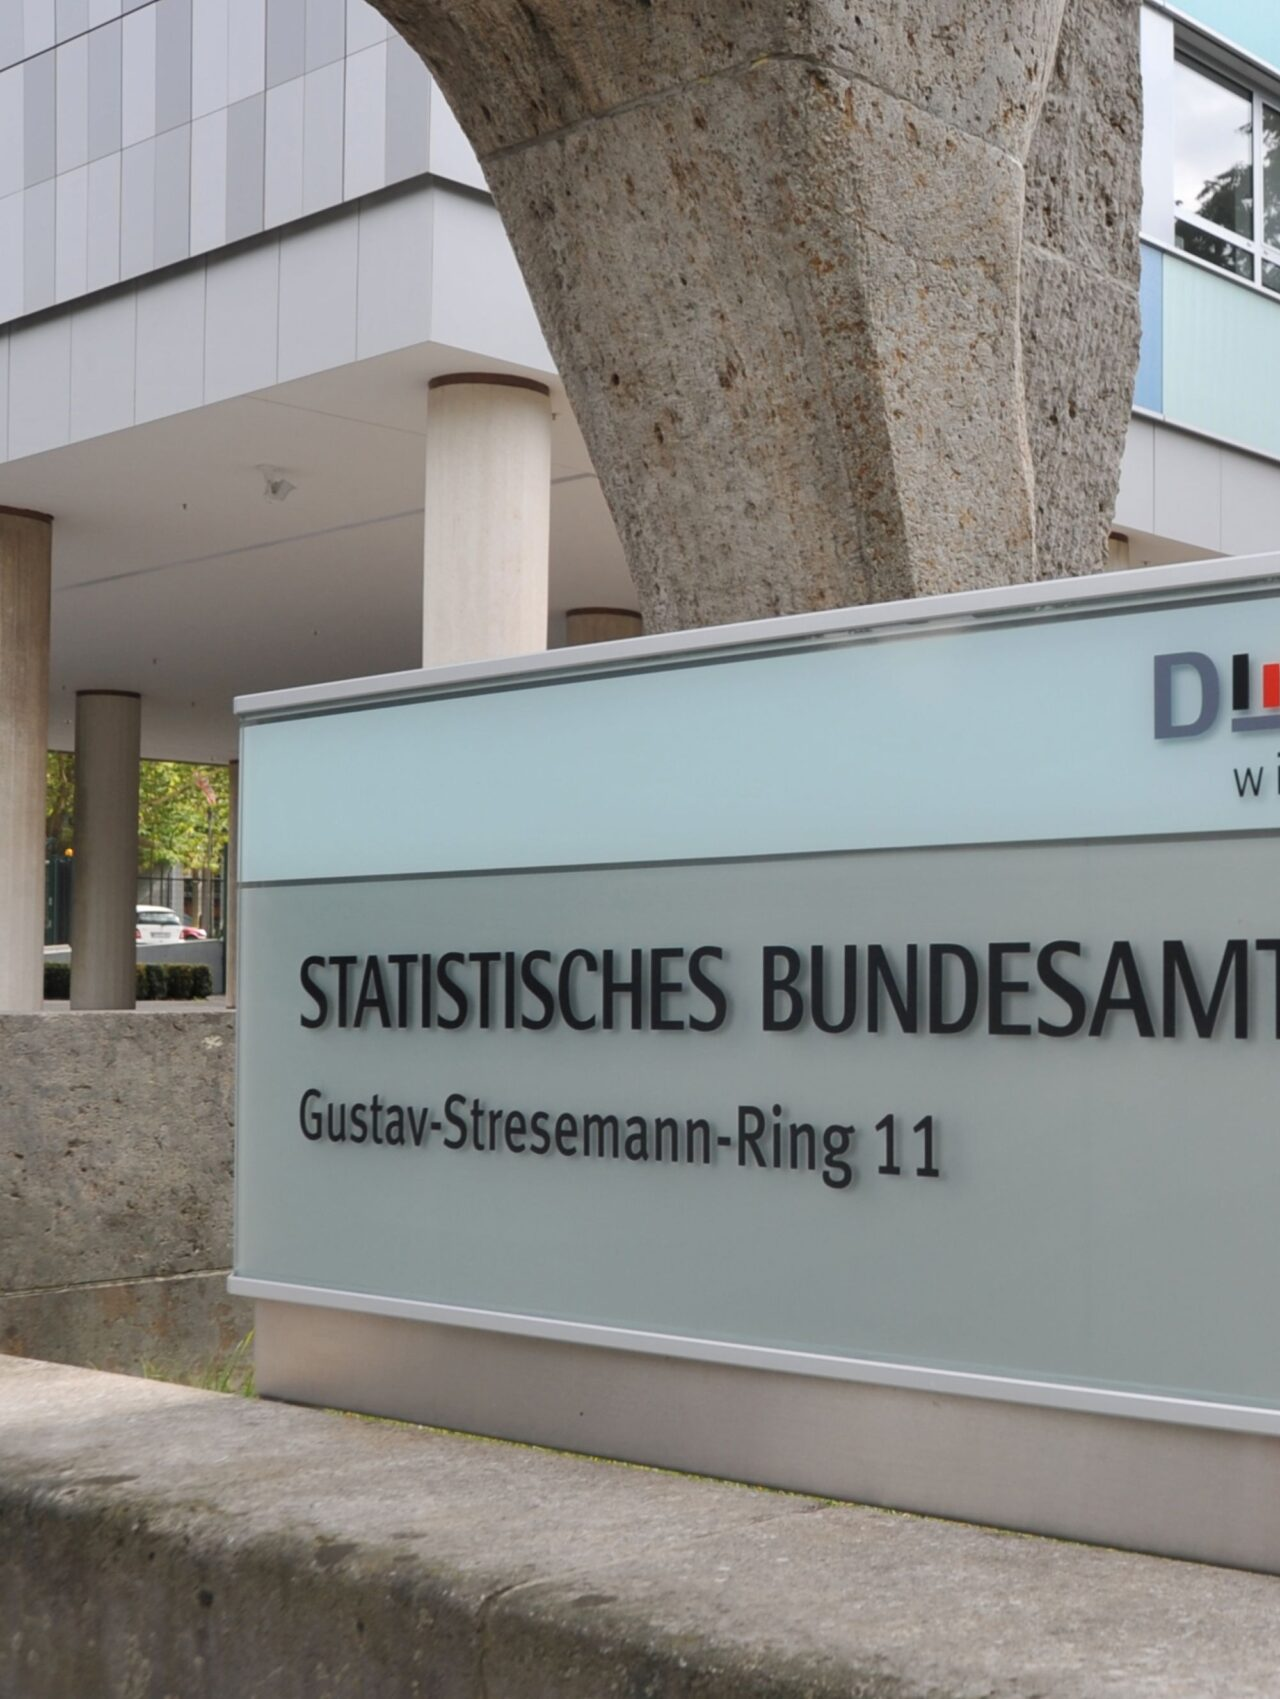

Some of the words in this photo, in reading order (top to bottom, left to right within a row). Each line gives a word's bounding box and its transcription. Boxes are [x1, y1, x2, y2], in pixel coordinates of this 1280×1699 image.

[299, 945, 727, 1033] STATISTISCHES
[299, 1089, 856, 1189] Gustav-Stresemann-Ring
[875, 1113, 940, 1178] 11
